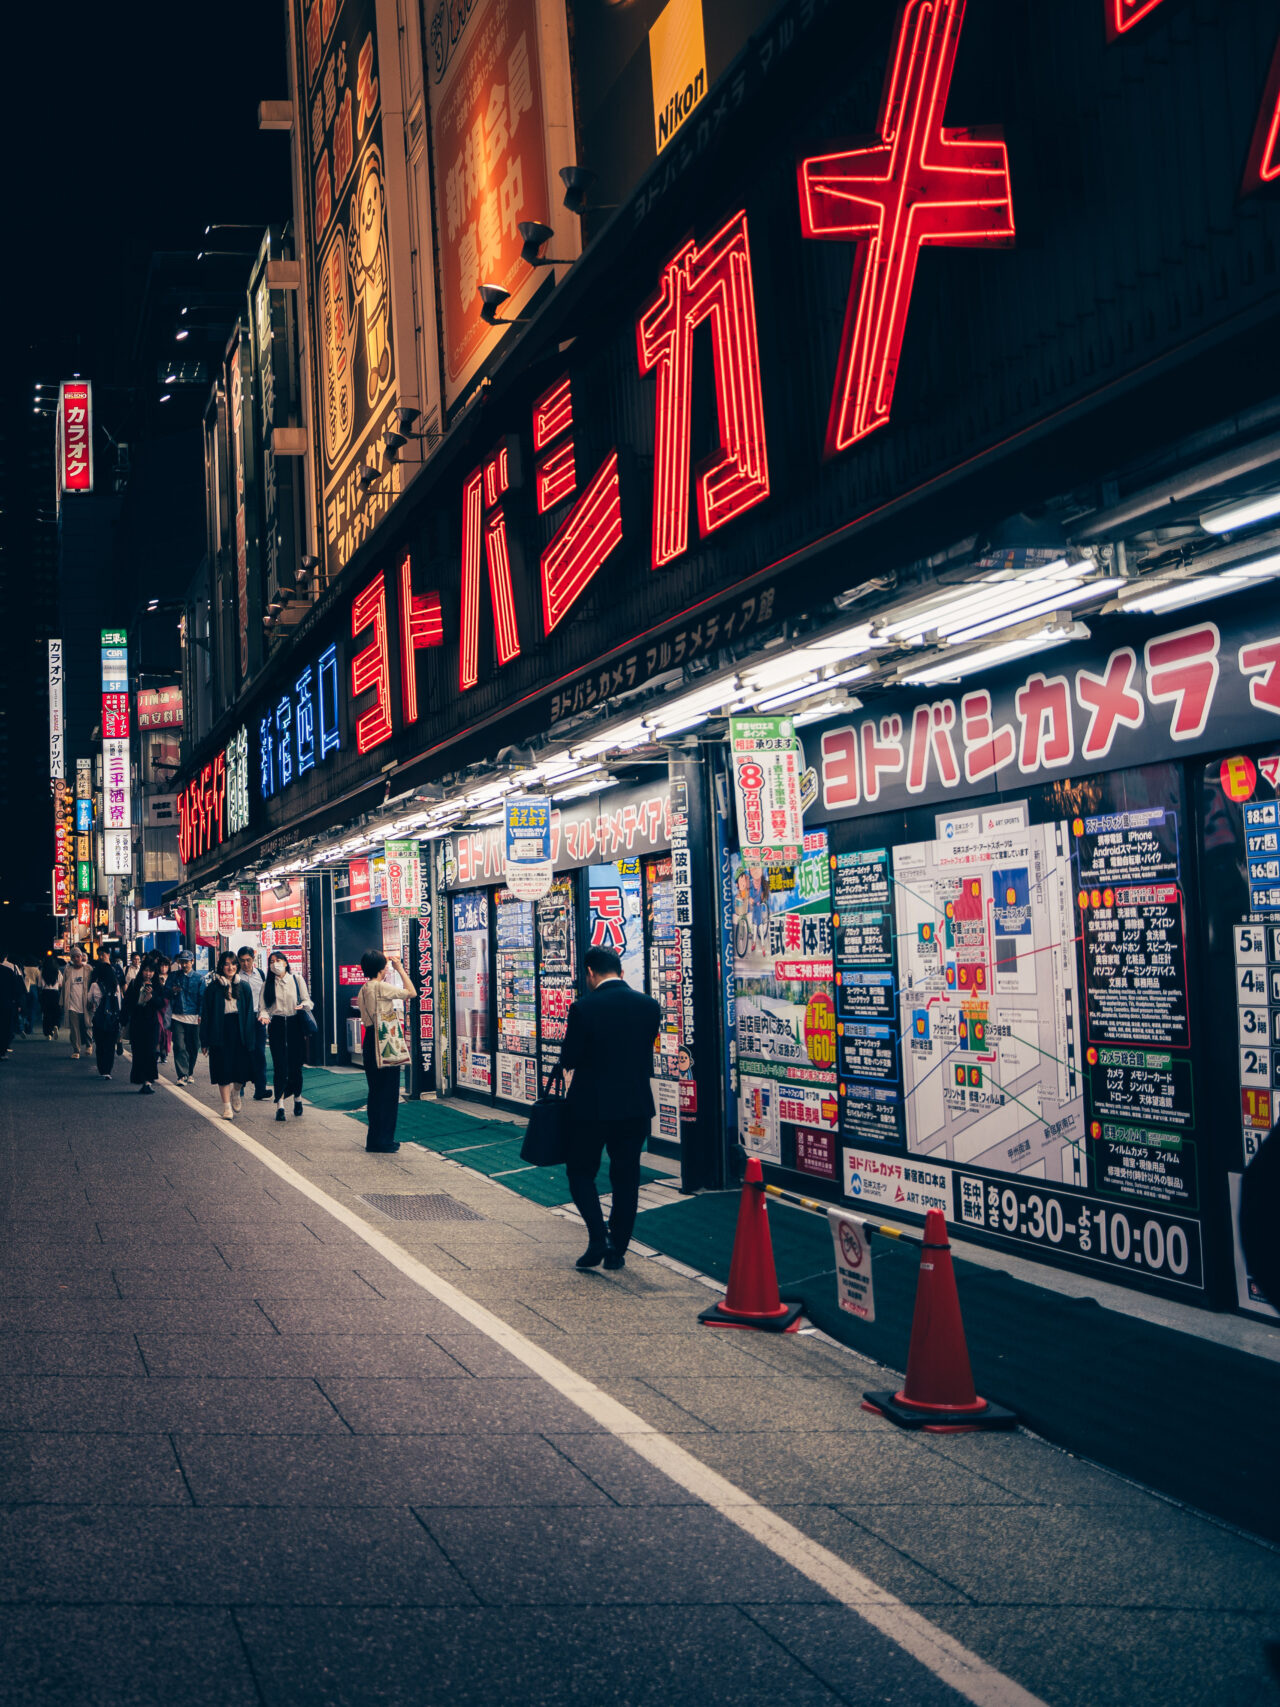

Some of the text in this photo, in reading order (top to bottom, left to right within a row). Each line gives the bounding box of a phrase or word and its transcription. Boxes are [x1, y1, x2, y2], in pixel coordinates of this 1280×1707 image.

[656, 67, 705, 143] Nikon
[446, 30, 533, 244] 新規会員
[457, 153, 524, 314] 募集中
[67, 406, 87, 477] カラオケ
[50, 642, 61, 685] カラオケ
[109, 682, 122, 690] 5F
[260, 643, 340, 798] 新宿西口
[820, 621, 1222, 811] ヨドバシカメラ
[51, 734, 62, 776] ダーツバー
[735, 738, 793, 750] 相談承ります
[1227, 756, 1249, 797] E
[510, 808, 546, 817] ネットで
[738, 763, 764, 843] 8万円値引き
[509, 816, 547, 826] 買えます
[1128, 831, 1153, 843] iPhone
[1092, 851, 1162, 869] お酒 電動自転車・バイク
[1093, 841, 1160, 857] Androidスマートフォン
[674, 852, 688, 886] 破損
[798, 851, 831, 899] 坂道
[676, 890, 690, 924] 盗難
[1093, 906, 1168, 919] 冷蔵庫 洗濯機 エアコン
[588, 888, 627, 956] モバ
[1088, 918, 1175, 931] 空気清浄機 掃除機 アイロン
[771, 913, 833, 956] 試乗体験
[1098, 930, 1167, 942] 炊飯器 レンジ 食洗機
[1238, 929, 1263, 953] 5階
[1089, 942, 1178, 953] テレビ ヘッドホン スピーカー
[1096, 954, 1171, 965] 美容家電 化粧品 血圧計
[418, 917, 433, 1038] マルチメディア館 南館
[1093, 966, 1176, 976] パソコン ゲーミングデバイス
[1240, 969, 1266, 994] 4階
[681, 928, 695, 1045] 今日お買い上げの商品から
[1109, 977, 1160, 989] 文房具 事務用品
[739, 1014, 792, 1036] 当店屋内にある
[1243, 1009, 1268, 1035] 3階
[423, 1053, 432, 1072] です
[1100, 1050, 1145, 1067] カメラ総合館
[1244, 1049, 1269, 1076] 2階
[1107, 1068, 1173, 1083] カメラ メモリーカード
[1107, 1080, 1154, 1093] レンズ ジンバル
[779, 1099, 820, 1124] 自転車売場
[1110, 1092, 1173, 1109] ドローン 天体望遠鏡
[1104, 1125, 1148, 1145] 修理・フィルム館
[1109, 1144, 1180, 1164] フィルムカメラ フィルム
[1123, 1157, 1166, 1173] 暗室・現像用品
[848, 1154, 946, 1190] ヨドバシカメラ 新宿西口本店
[1108, 1166, 1184, 1189] 修理受付(時計以外の製品)
[961, 1180, 982, 1199] 年中
[906, 1193, 947, 1212] ART SPORTS
[963, 1201, 983, 1221] 無休
[987, 1185, 999, 1228] あさ
[1078, 1205, 1091, 1251] よる
[1093, 1210, 1189, 1276] 10:00
